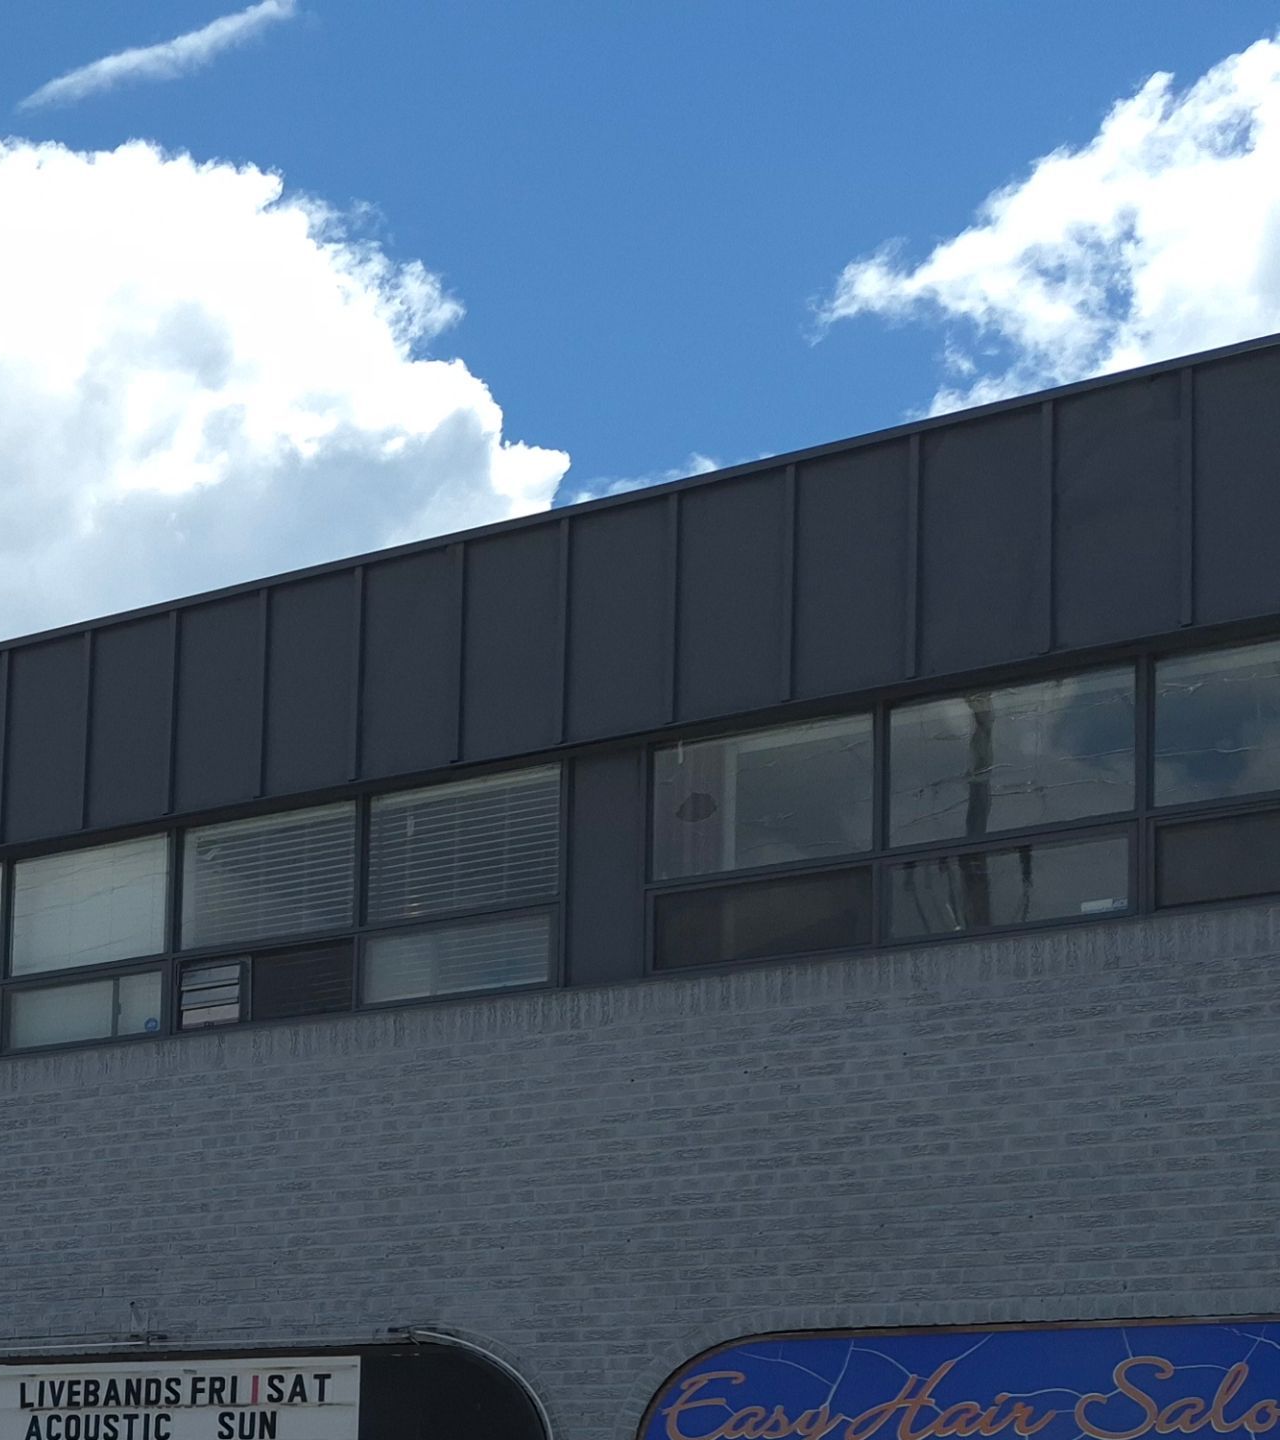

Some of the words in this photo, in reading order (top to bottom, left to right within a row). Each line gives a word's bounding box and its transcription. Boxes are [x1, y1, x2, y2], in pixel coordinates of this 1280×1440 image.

[19, 1377, 181, 1409] LIVEBANDS
[190, 1376, 238, 1405] FRI
[267, 1373, 332, 1404] SAT
[217, 1411, 278, 1440] SUN
